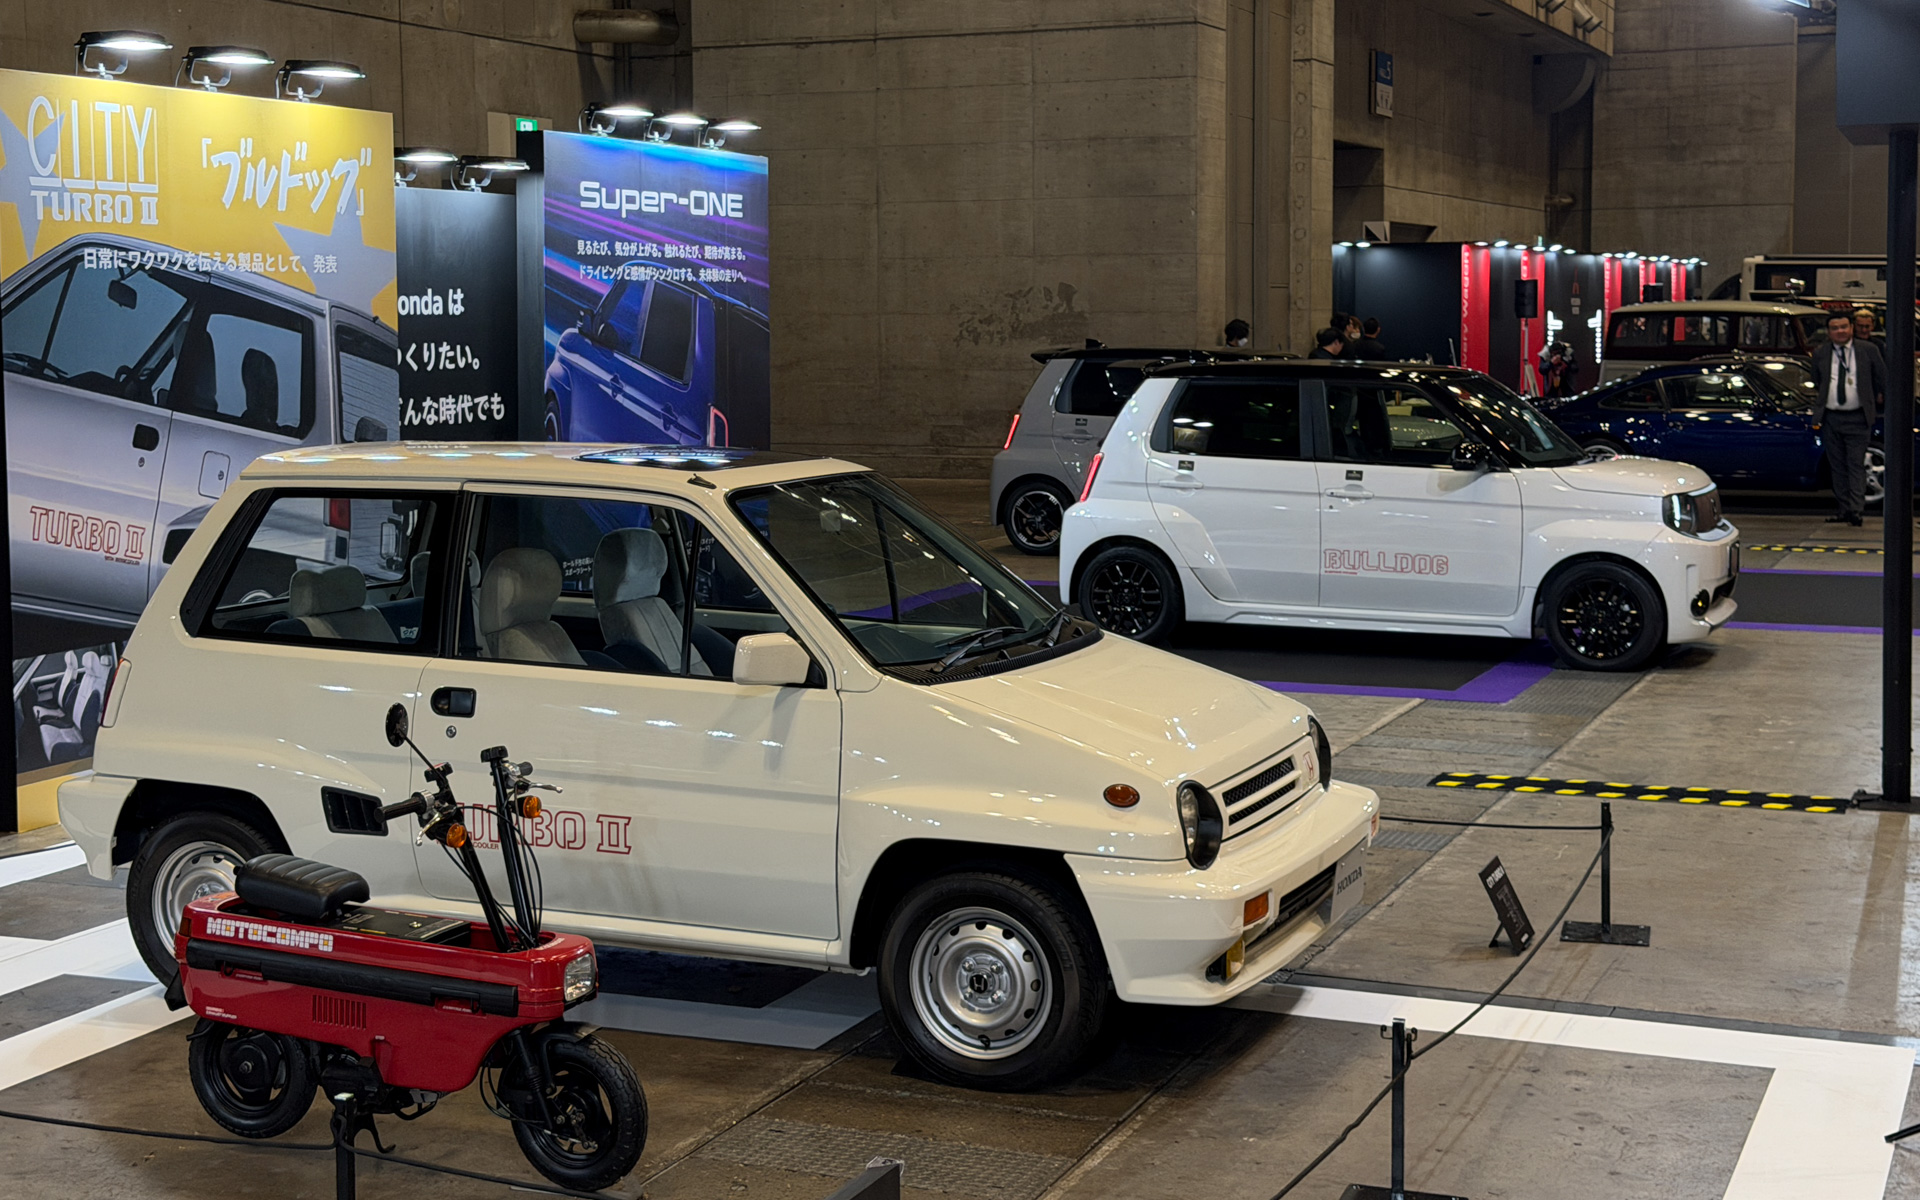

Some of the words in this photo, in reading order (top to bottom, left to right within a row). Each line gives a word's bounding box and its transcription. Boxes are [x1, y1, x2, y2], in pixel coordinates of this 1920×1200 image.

[28, 96, 154, 186] CITY
[201, 137, 372, 217] 「ブルドッグ」
[30, 190, 133, 225] TURBO
[140, 196, 159, 226] II
[579, 180, 744, 218] Super-ONE
[83, 247, 338, 275] 日常にワクワクを伝える製品として、発表
[397, 288, 443, 316] onda
[448, 288, 465, 315] は
[397, 341, 480, 372] くりたい。
[398, 392, 505, 427] んな時代でも
[30, 505, 121, 555] TURBO
[1323, 548, 1449, 576] BULLDOG
[596, 814, 632, 855] II
[206, 916, 334, 952] MOTOCOMPO
